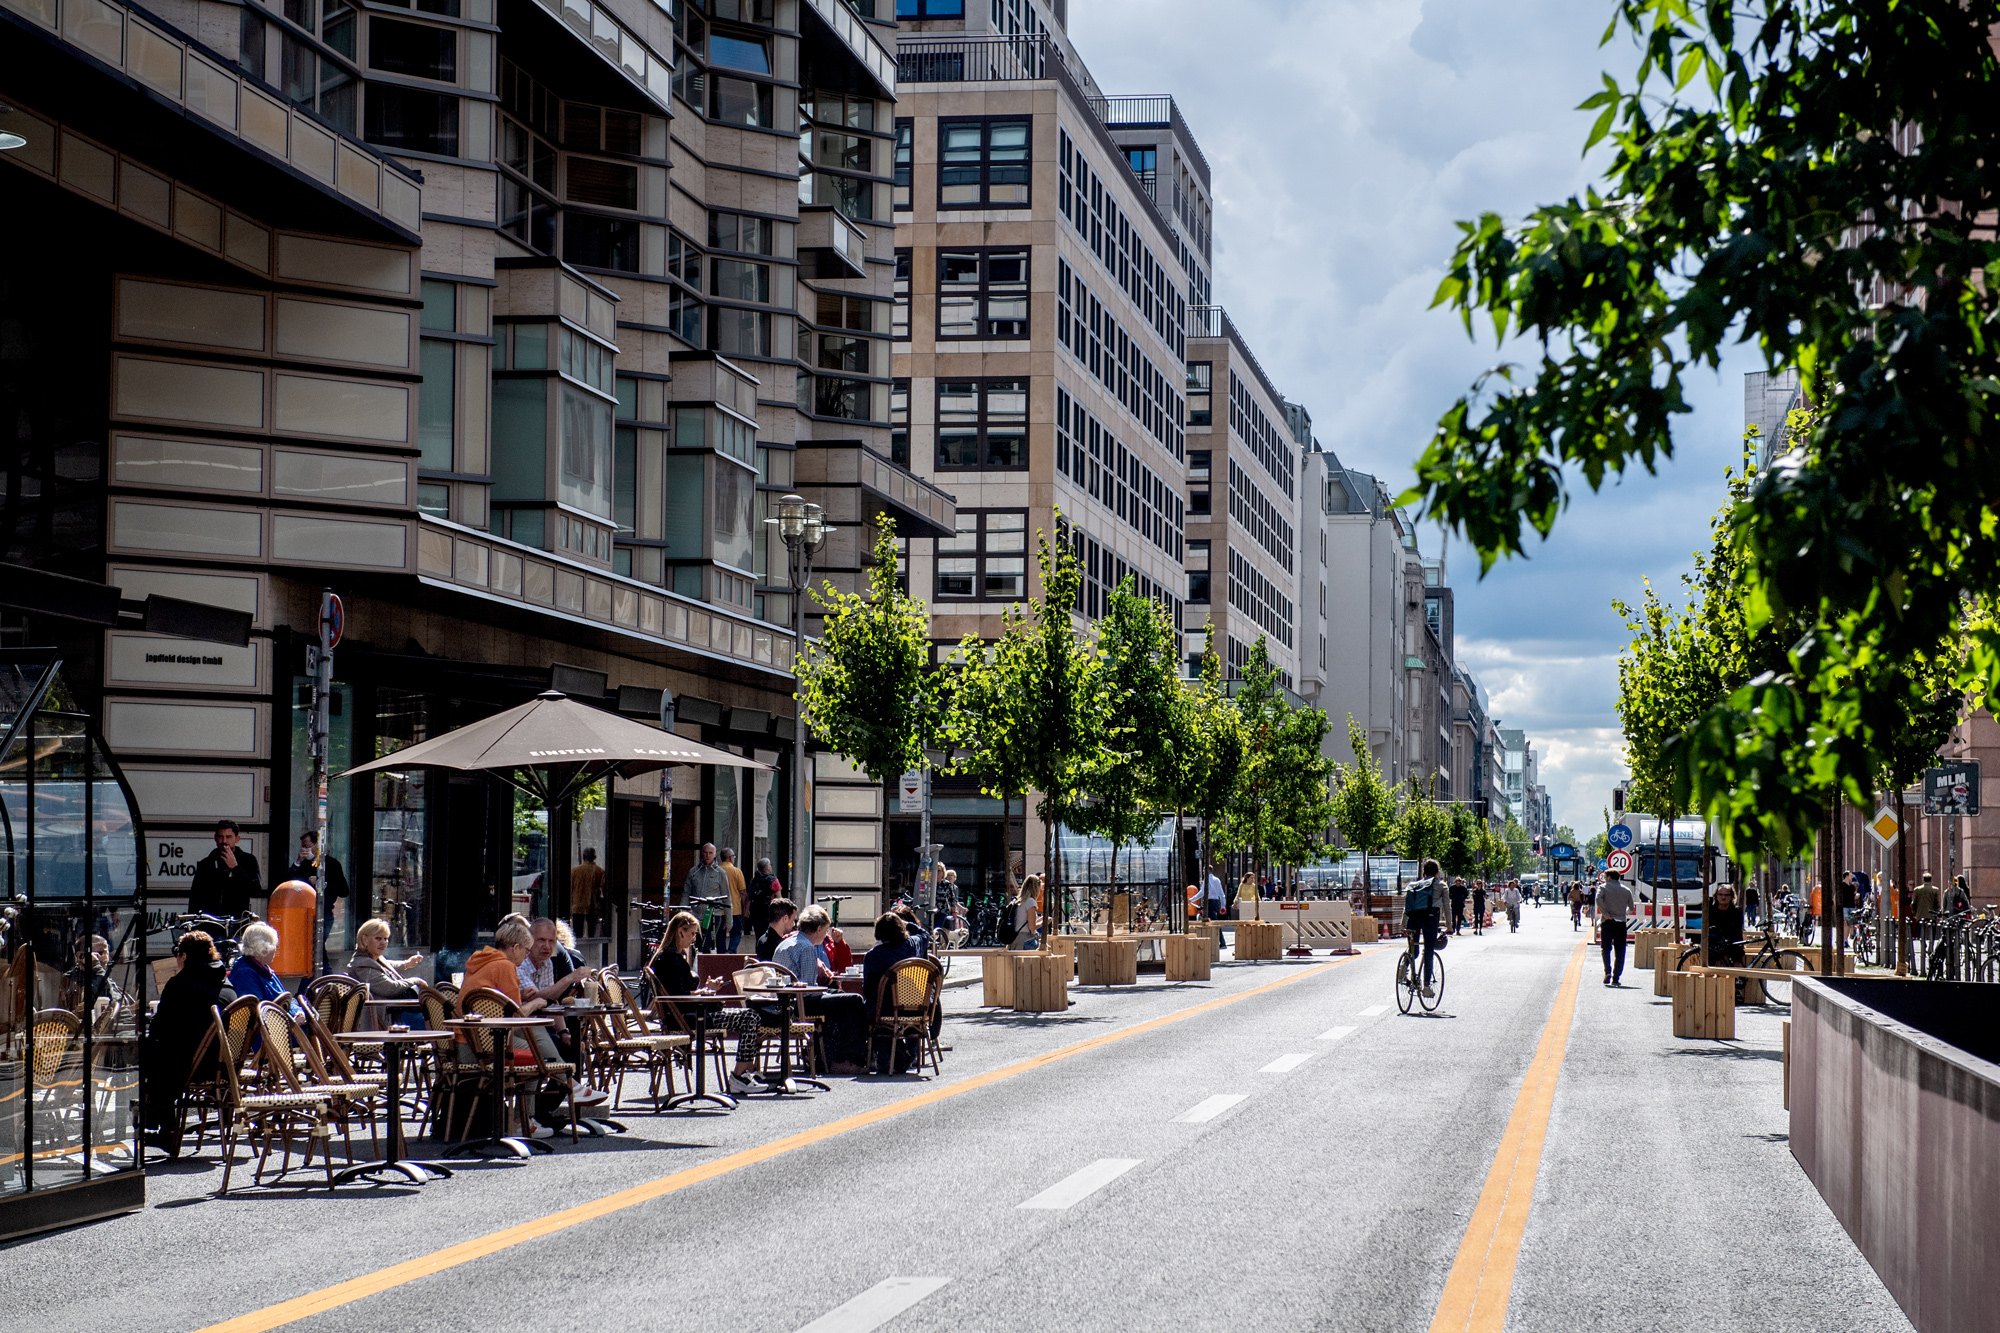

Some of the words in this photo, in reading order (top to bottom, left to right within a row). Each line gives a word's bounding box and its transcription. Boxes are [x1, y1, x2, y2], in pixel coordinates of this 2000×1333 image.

[145, 653, 176, 663] jagdfeld
[177, 655, 201, 665] design
[202, 656, 223, 665] GmbH
[529, 748, 605, 756] EINSTEIN
[633, 748, 701, 757] KAFFEE
[1936, 772, 1966, 787] MLM
[159, 842, 183, 858] Die
[158, 861, 198, 876] Auto
[1613, 857, 1626, 868] 20
